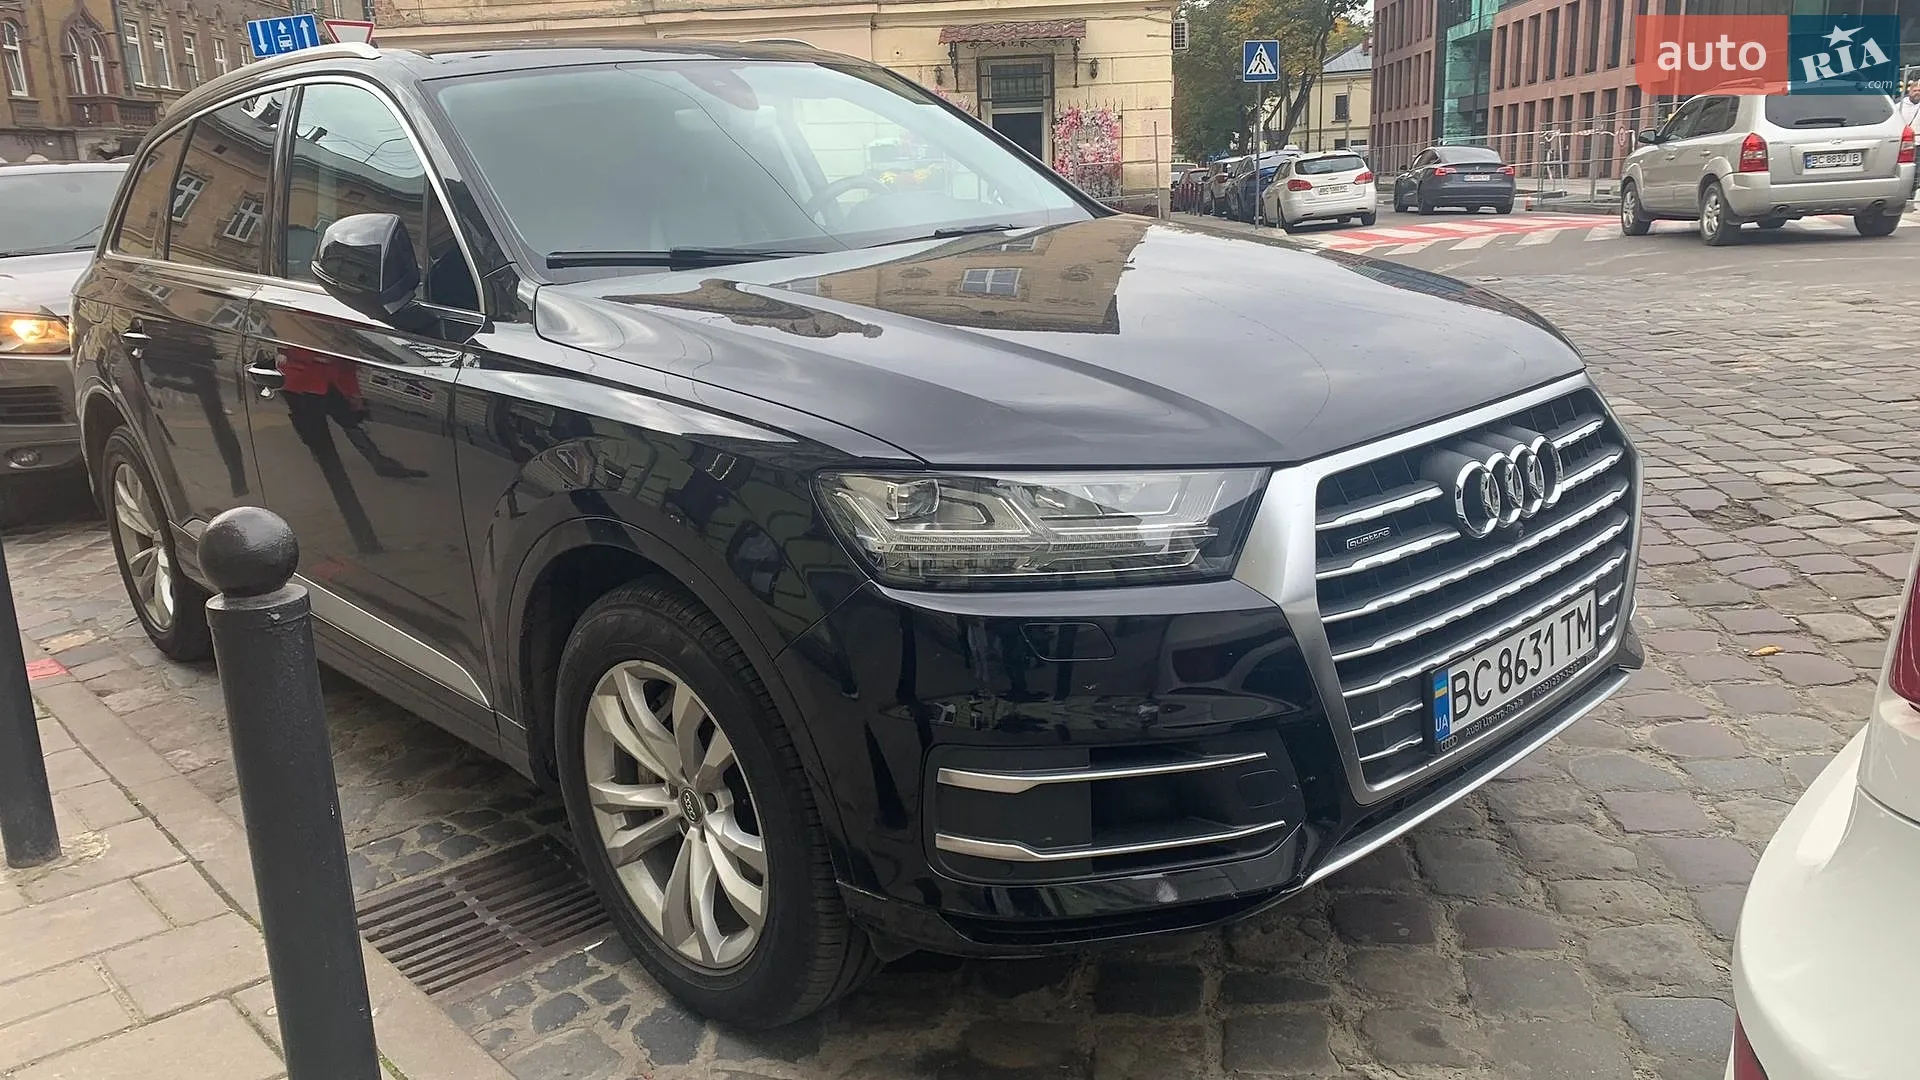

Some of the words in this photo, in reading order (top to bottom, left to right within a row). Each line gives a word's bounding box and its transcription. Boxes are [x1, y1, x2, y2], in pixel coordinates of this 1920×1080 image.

[1451, 659, 1493, 722] BC
[1499, 622, 1554, 694] 8631
[1560, 600, 1592, 656] TM
[1435, 715, 1449, 732] UA
